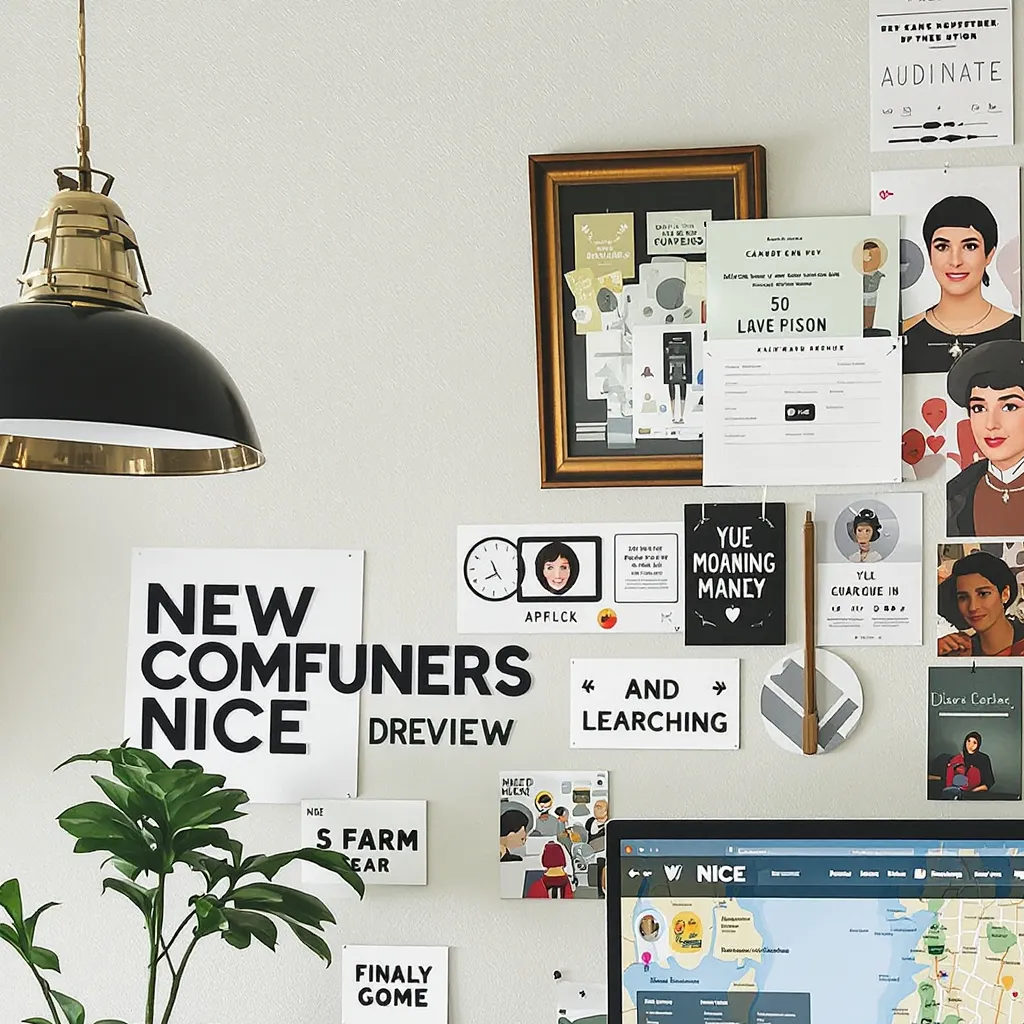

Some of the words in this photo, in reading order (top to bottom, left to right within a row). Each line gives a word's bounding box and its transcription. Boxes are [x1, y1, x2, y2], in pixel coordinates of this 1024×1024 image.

[881, 61, 1002, 87] AUDINATE
[771, 297, 790, 312] 50
[738, 318, 774, 333] LAVE
[780, 317, 827, 332] PISON
[717, 526, 753, 549] YUE
[693, 552, 776, 574] MOANING
[147, 582, 316, 638] NEW
[141, 640, 533, 697] COMFUNERS
[625, 678, 680, 700] AND
[141, 696, 308, 755] NICE
[369, 717, 514, 745] DREVIEW
[582, 710, 728, 733] LEARCHING
[316, 828, 332, 850] S
[343, 828, 418, 851] FARM
[696, 865, 747, 883] NICE
[356, 964, 433, 984] FINALY
[358, 987, 428, 1007] GOME
